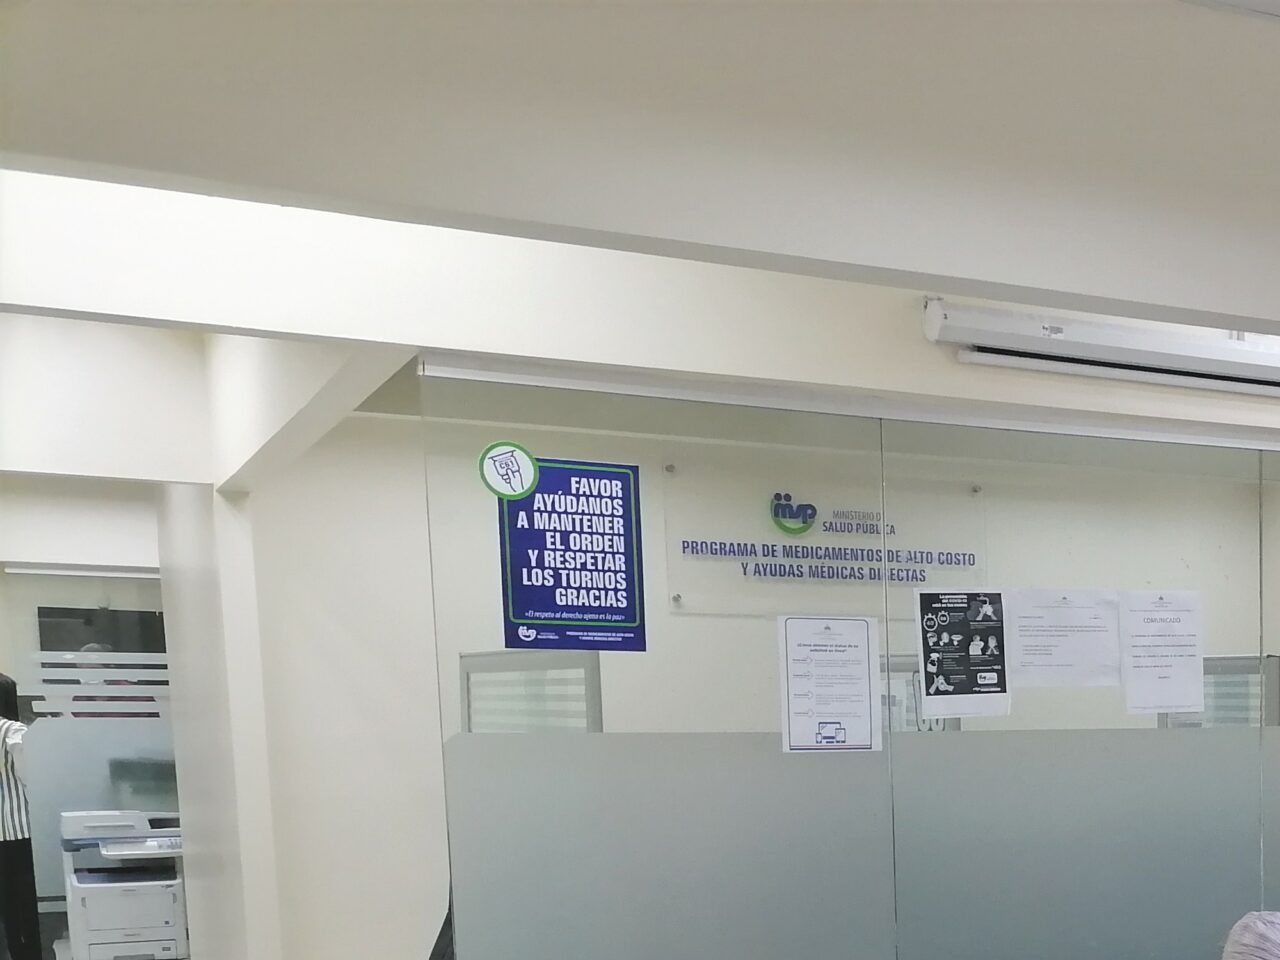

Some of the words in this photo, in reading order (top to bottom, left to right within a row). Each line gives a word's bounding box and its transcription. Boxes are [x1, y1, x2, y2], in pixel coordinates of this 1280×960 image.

[570, 476, 623, 498] FAVOR
[533, 491, 624, 516] AYÚDANOS
[516, 511, 529, 529] A
[533, 512, 624, 534] MANTENER
[832, 510, 874, 521] MINISTERIO
[822, 521, 854, 533] SALUD
[545, 532, 565, 550] EL
[569, 533, 625, 553] ORDEN
[682, 540, 758, 557] PROGRAMA
[761, 543, 778, 558] DE
[782, 544, 882, 562] MEDICAMENTOS
[887, 549, 901, 563] DE
[905, 550, 933, 564] ALTO
[938, 552, 976, 566] COSTO
[527, 549, 539, 567] Y
[543, 550, 626, 571] RESPETAR
[741, 562, 749, 576] Y
[753, 562, 804, 578] AYUDAS
[808, 561, 864, 580] MÉDICAS
[522, 568, 554, 587] LOS
[558, 570, 627, 590] TURNOS
[555, 588, 628, 608] GRACIAS
[534, 611, 555, 619] respeto
[561, 611, 583, 619] derecho
